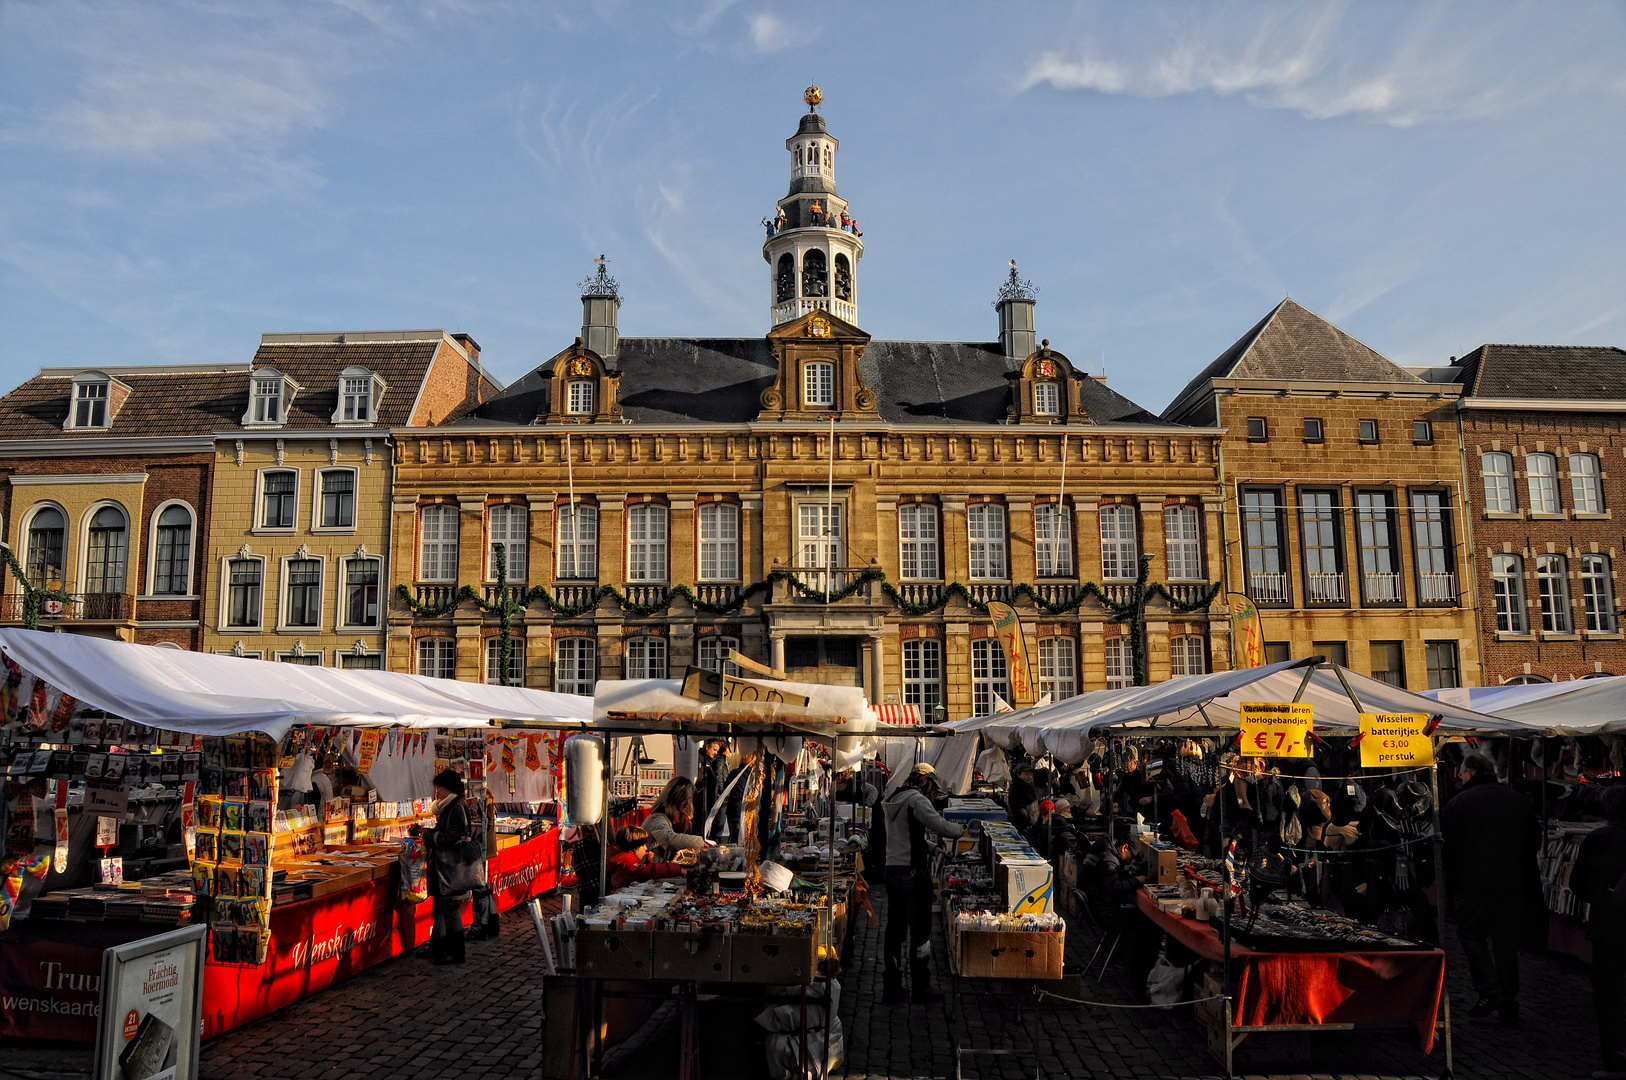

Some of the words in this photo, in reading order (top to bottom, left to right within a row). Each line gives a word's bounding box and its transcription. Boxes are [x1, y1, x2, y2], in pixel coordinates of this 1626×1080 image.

[1291, 706, 1311, 714] leren
[1246, 716, 1308, 726] horlogebandjes
[1375, 714, 1414, 723] Wisselen
[1371, 727, 1420, 737] batterijtjes
[1254, 731, 1268, 750] €
[1273, 732, 1300, 753] 7,-
[1383, 740, 1389, 748] €
[1390, 740, 1409, 748] 3,00
[1379, 754, 1394, 762] per
[1396, 752, 1415, 760] stuk
[9, 825, 31, 839] 50
[292, 920, 378, 970] Wenskaarten
[148, 964, 177, 982] Prachtig
[142, 973, 179, 995] Roermond
[128, 1013, 137, 1025] 21
